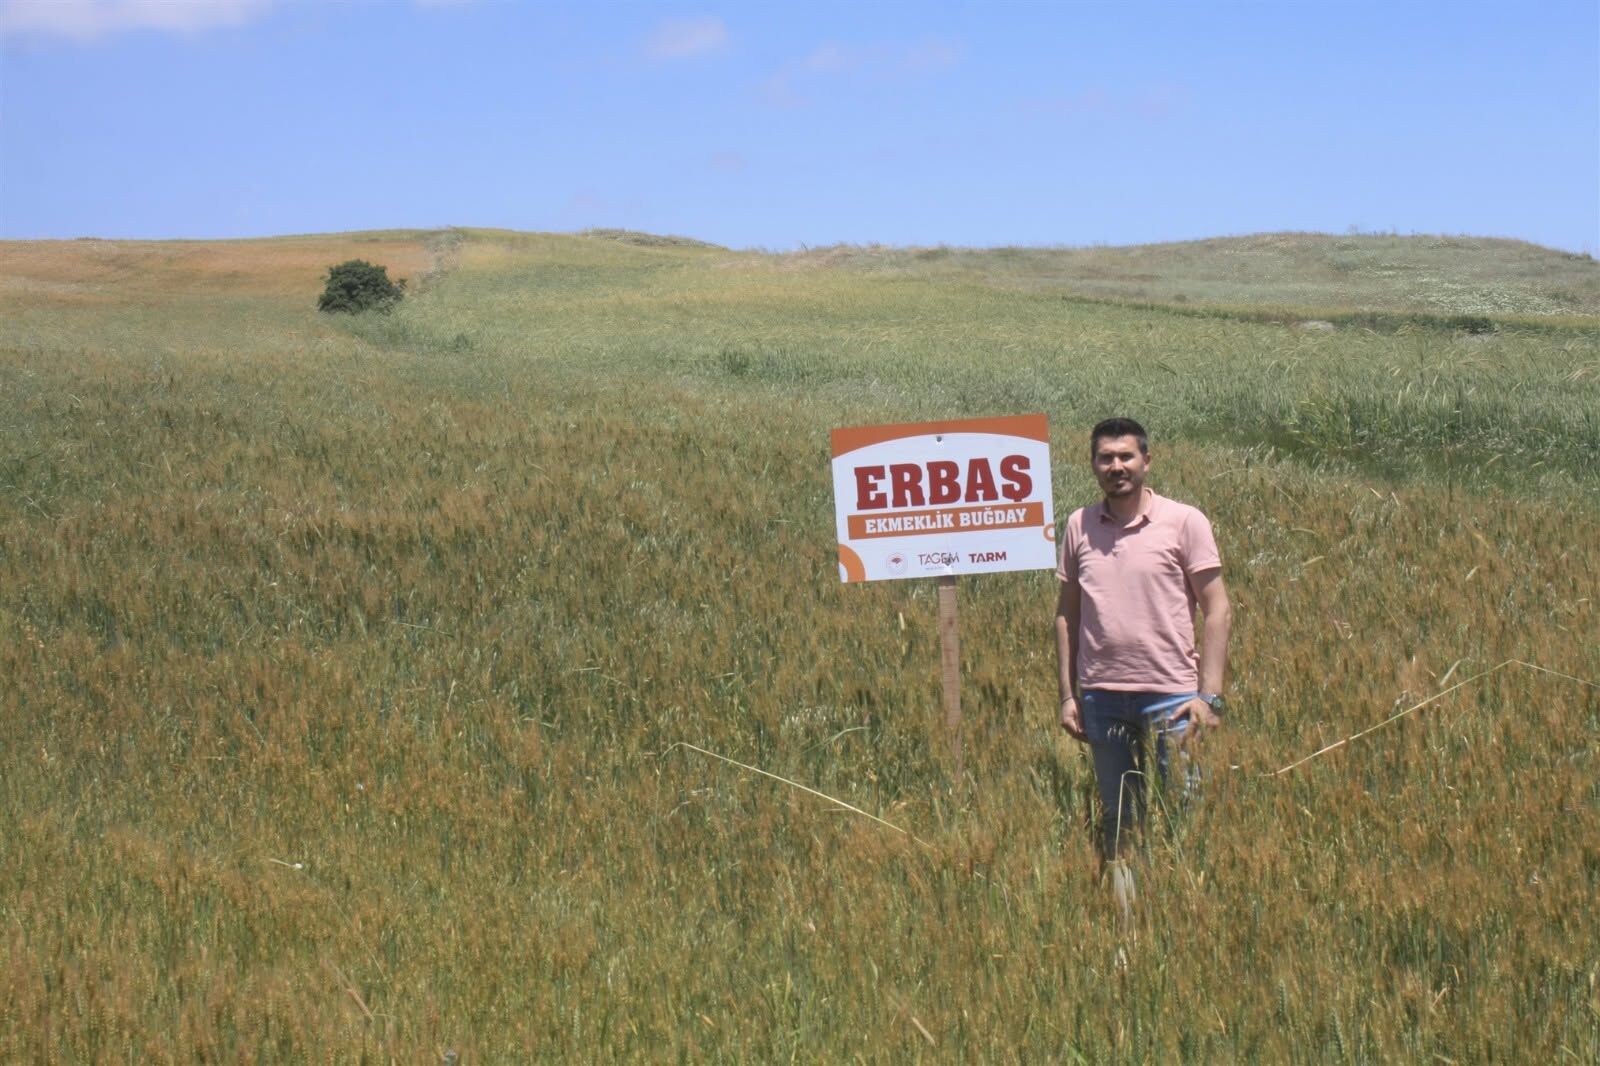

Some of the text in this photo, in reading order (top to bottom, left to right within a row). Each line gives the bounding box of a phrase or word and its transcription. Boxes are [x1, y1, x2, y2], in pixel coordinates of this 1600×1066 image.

[854, 454, 1033, 510] ERBAŞ
[865, 507, 1027, 534] EKMEKLİK BUĞDAY
[968, 551, 1007, 564] TARM
